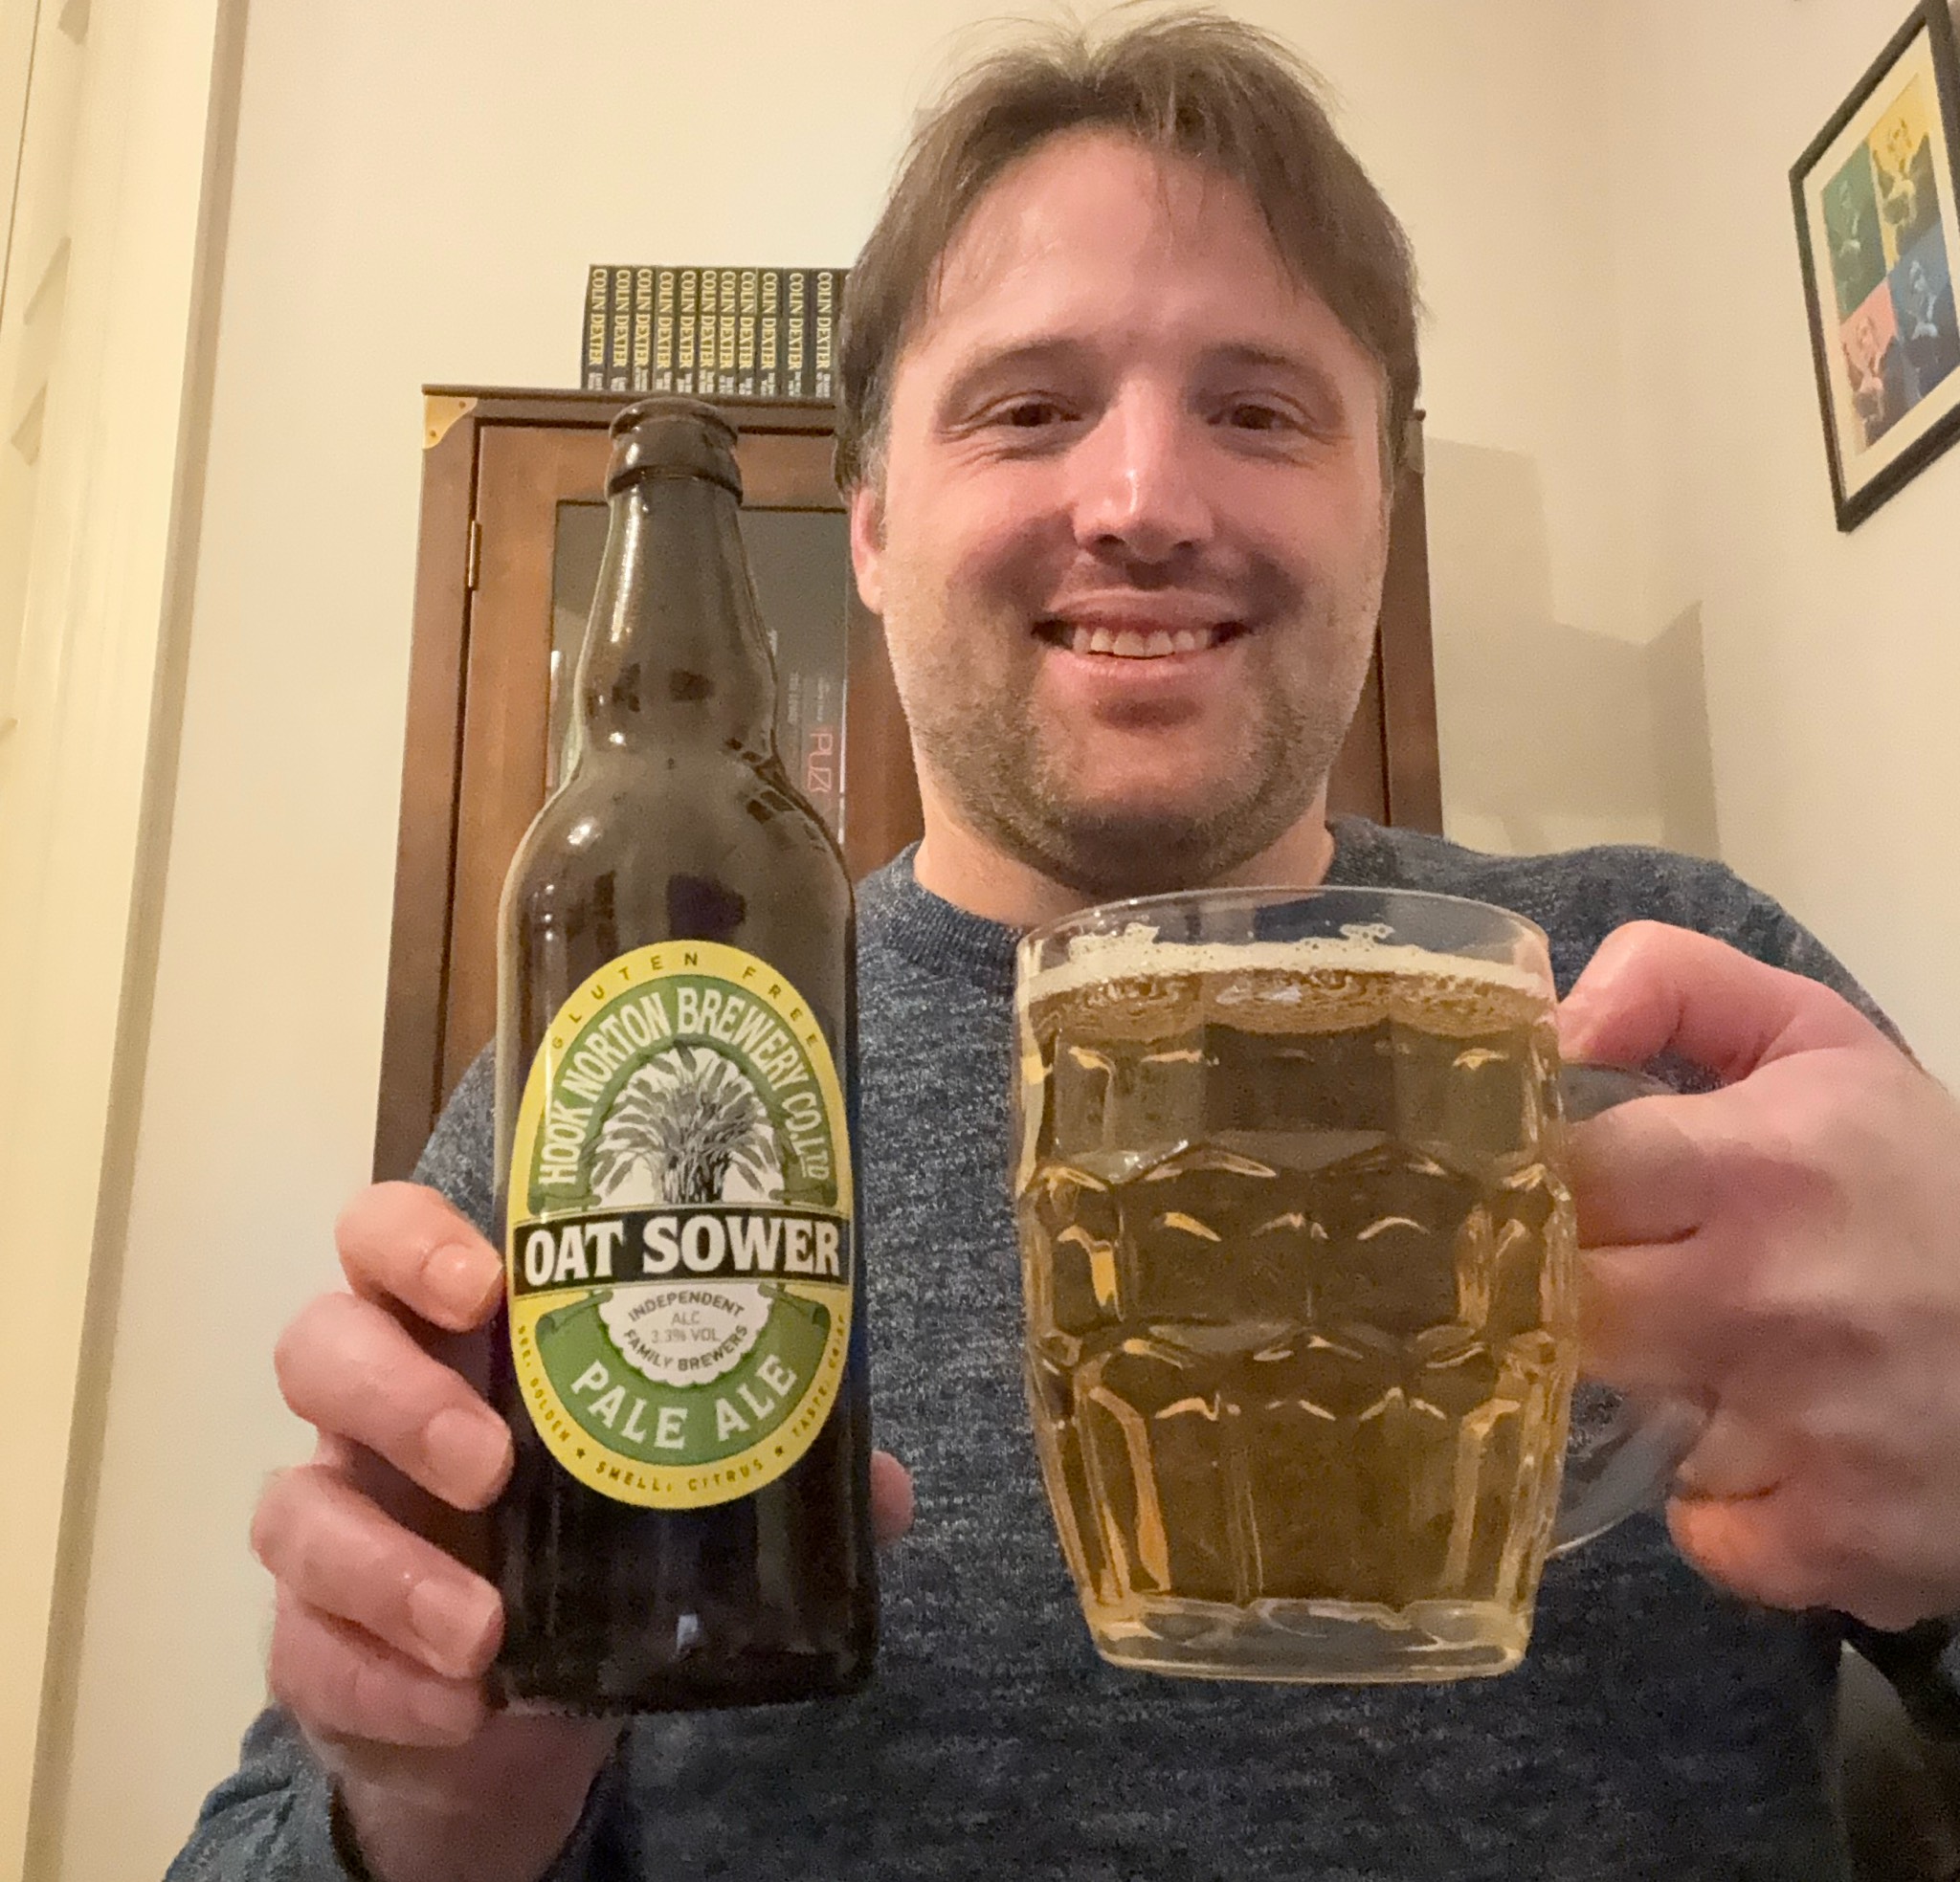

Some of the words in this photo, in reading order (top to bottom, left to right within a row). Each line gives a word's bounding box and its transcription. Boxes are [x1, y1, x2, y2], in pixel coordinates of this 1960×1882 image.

[592, 269, 607, 310] COLIN
[615, 270, 631, 311] COLIN
[636, 269, 653, 310] COLIN
[658, 271, 674, 313] COLIN
[680, 271, 696, 312] COLIN
[702, 270, 717, 312] COLIN
[721, 271, 736, 313] COLIN
[741, 272, 755, 312] COLIN
[762, 272, 777, 314] COLIN
[789, 273, 804, 314] COLIN
[817, 272, 833, 313] COLIN
[589, 313, 605, 365] DEXTER
[612, 315, 630, 367] DEXTER
[635, 313, 651, 366] DEXTER
[657, 317, 673, 368] DEXTER
[679, 316, 695, 368] DEXTER
[700, 315, 716, 367] DEXTER
[720, 317, 735, 369] DEXTER
[739, 317, 754, 369] DEXTER
[761, 318, 776, 370] DEXTER
[788, 318, 803, 370] DEXTER
[816, 317, 832, 369] DEXTER
[551, 952, 698, 1050] GLUTEN
[743, 965, 818, 1048] FREE
[562, 992, 671, 1101] NORTON
[677, 986, 809, 1092] BREWERY
[539, 1101, 591, 1184] HOOK
[525, 1220, 623, 1287] OAT
[642, 1215, 839, 1277] SOWER
[628, 1290, 745, 1322] INDEPENDENT
[672, 1311, 700, 1325] ALC
[624, 1329, 673, 1368] FAMILY
[678, 1325, 747, 1371] BREWERS
[571, 1360, 688, 1450] PALE
[715, 1354, 798, 1442] ALE
